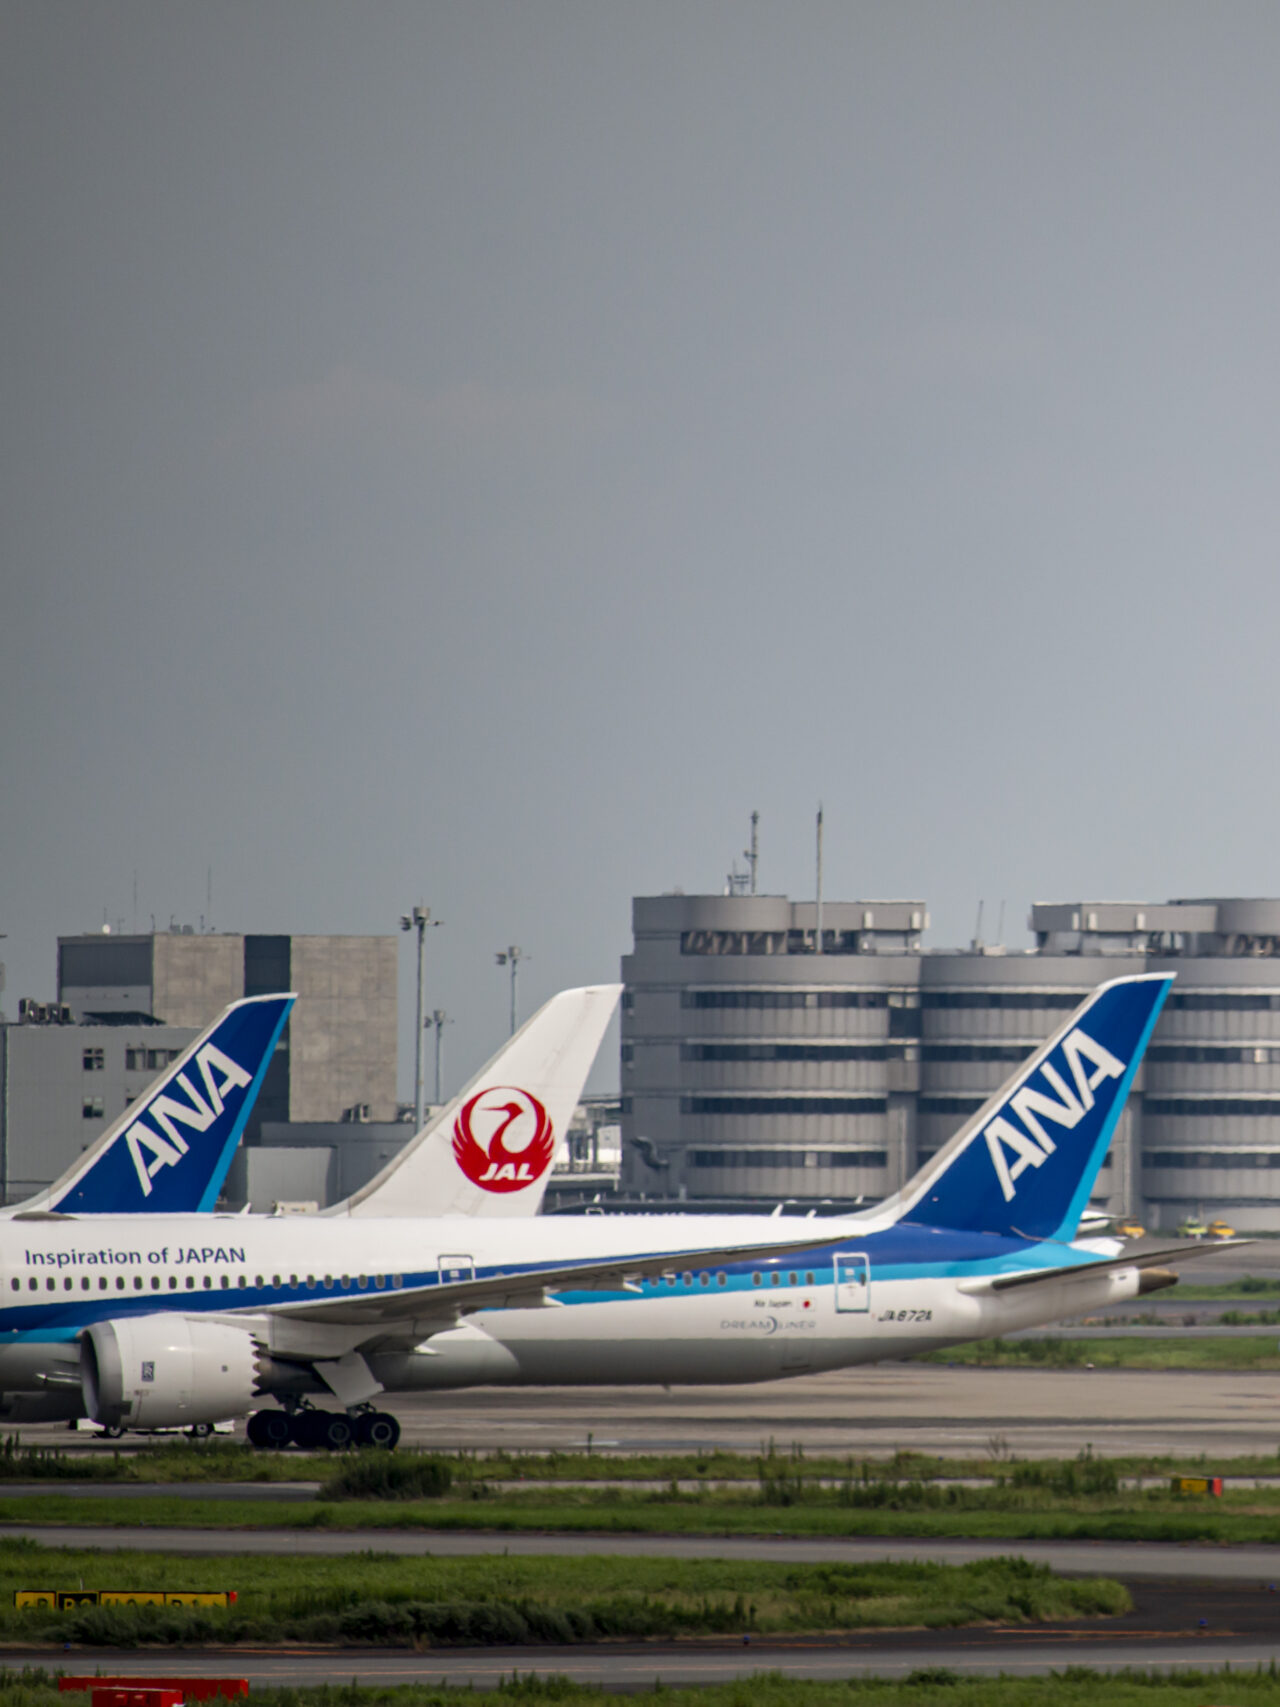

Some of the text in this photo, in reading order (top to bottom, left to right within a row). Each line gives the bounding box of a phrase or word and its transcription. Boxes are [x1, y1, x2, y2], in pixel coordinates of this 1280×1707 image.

[125, 1042, 253, 1198] ANA
[983, 1027, 1127, 1203] ANA
[479, 1162, 534, 1181] JAL
[25, 1247, 246, 1268] Inspiration of JAPAN
